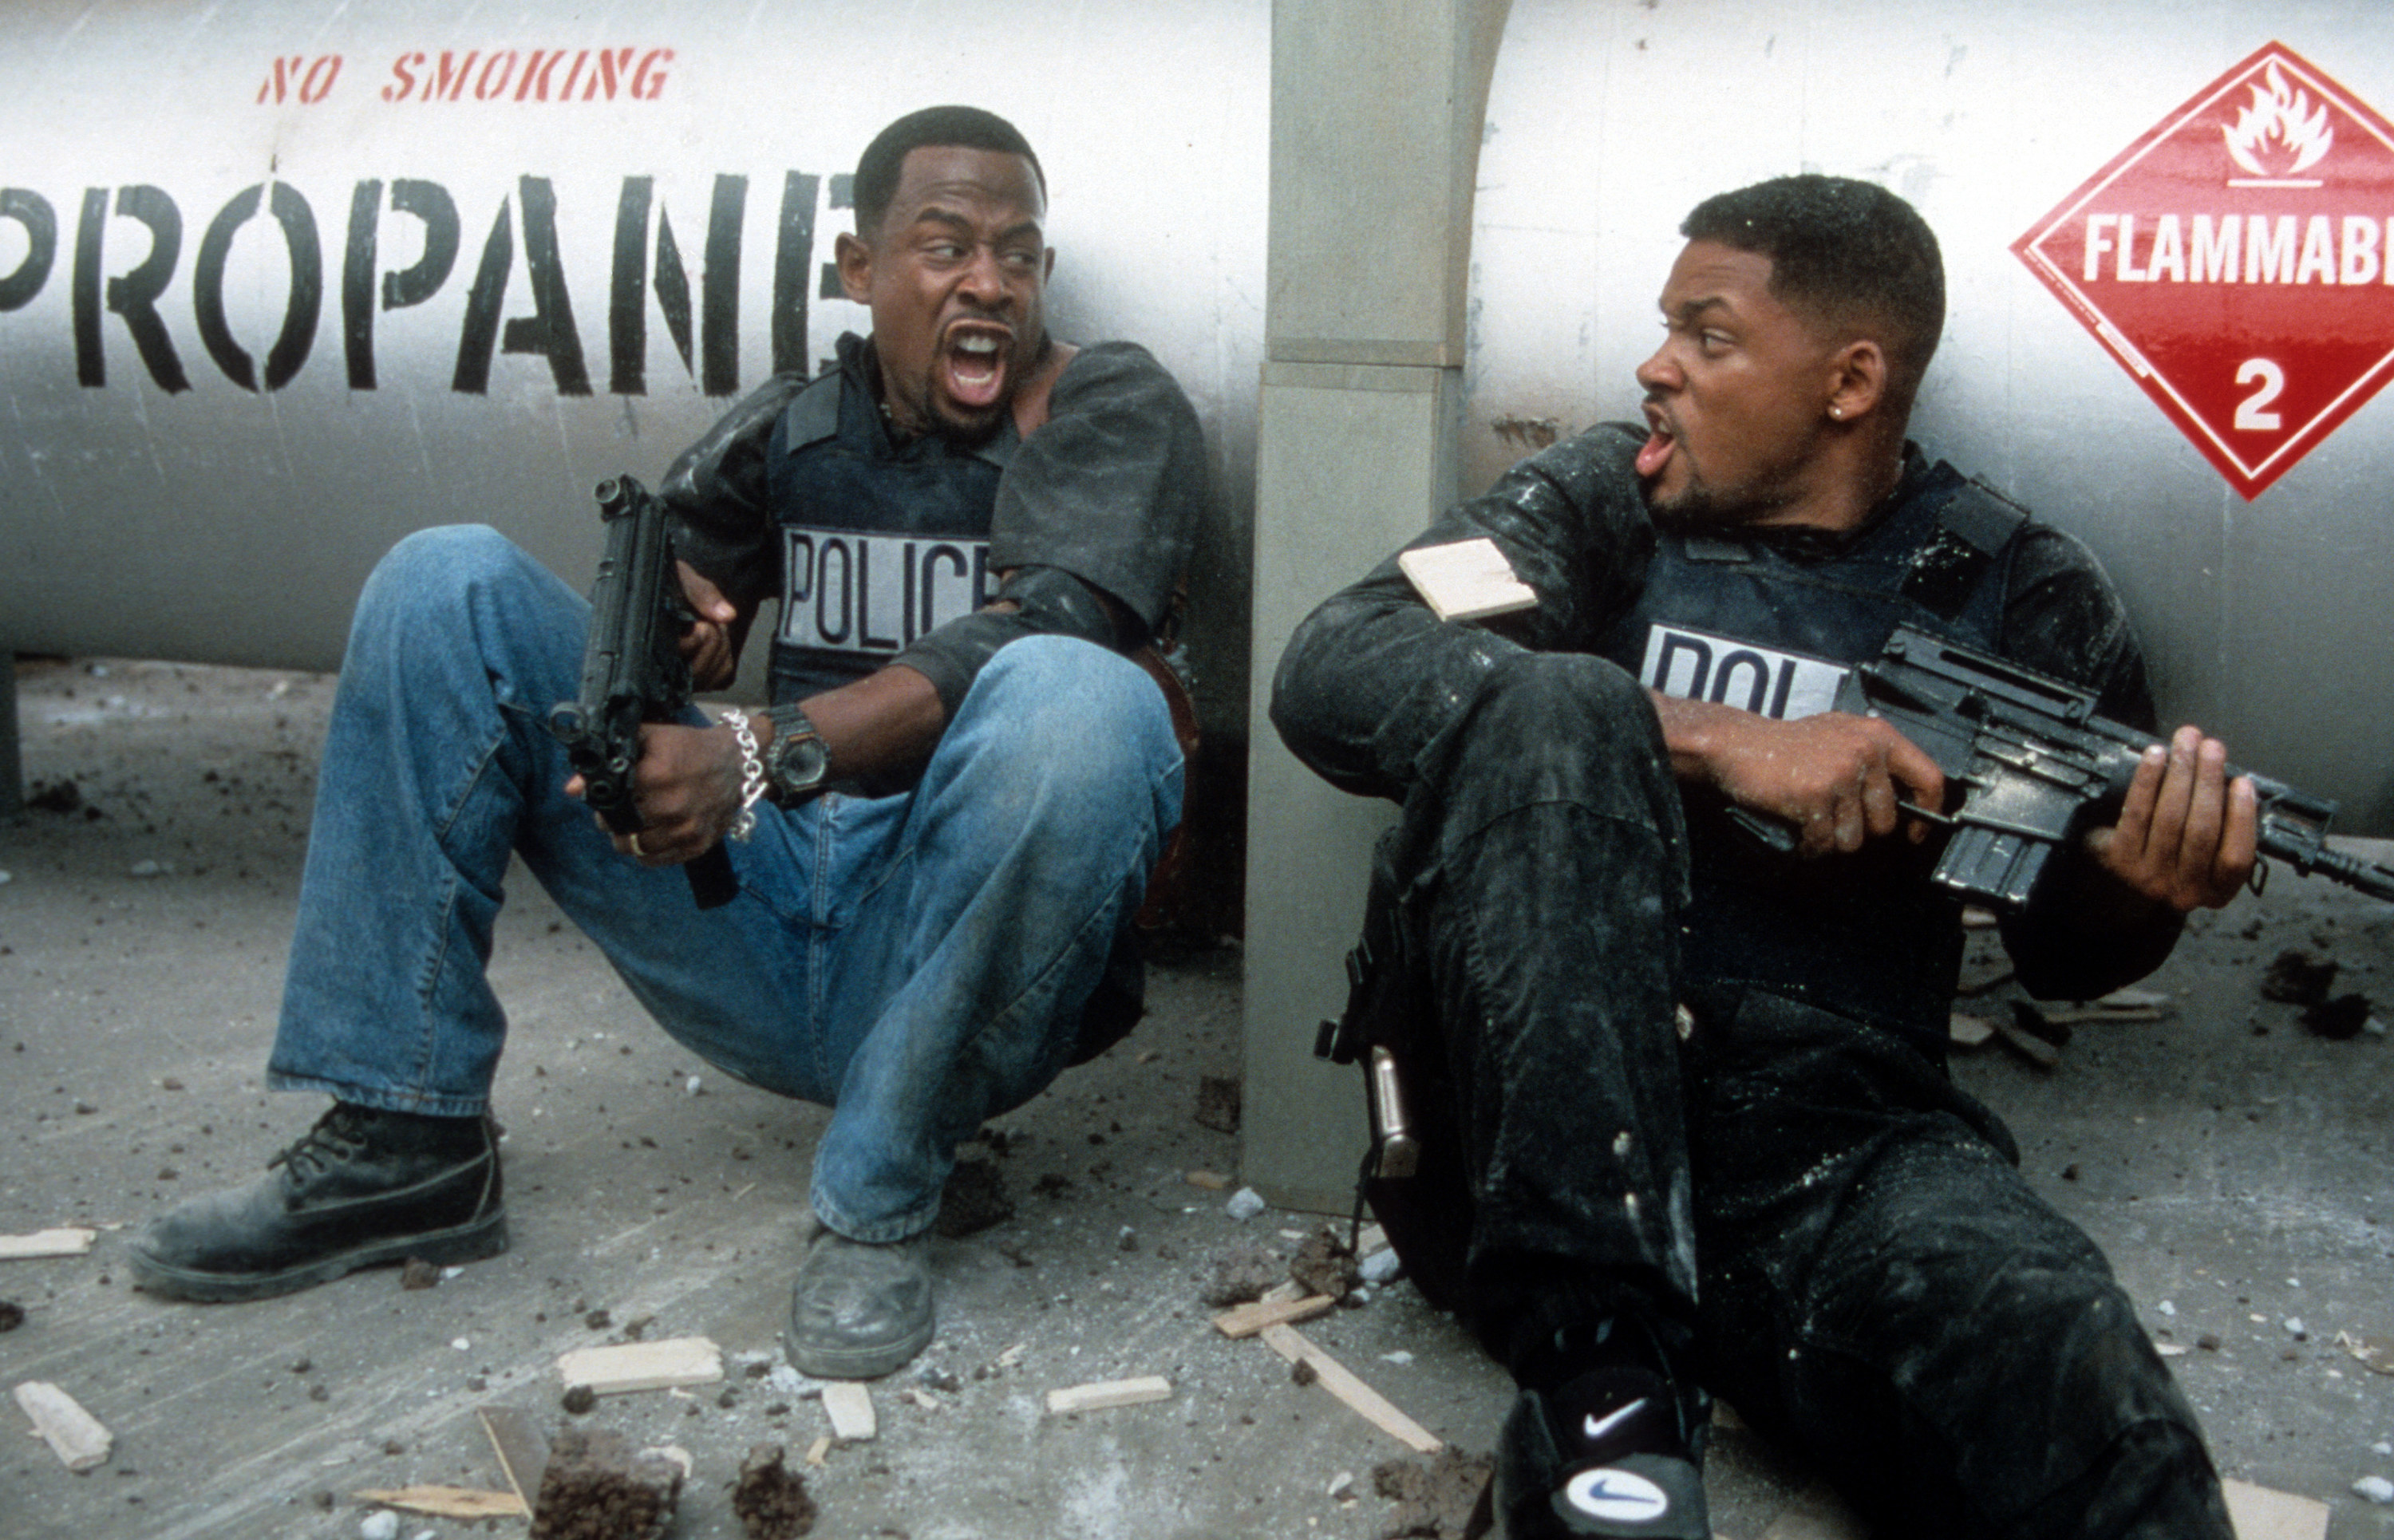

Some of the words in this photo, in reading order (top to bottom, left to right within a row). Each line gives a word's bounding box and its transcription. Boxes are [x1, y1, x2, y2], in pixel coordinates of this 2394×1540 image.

[256, 54, 343, 106] NO
[381, 47, 676, 102] SMOKING
[2234, 357, 2285, 431] 2
